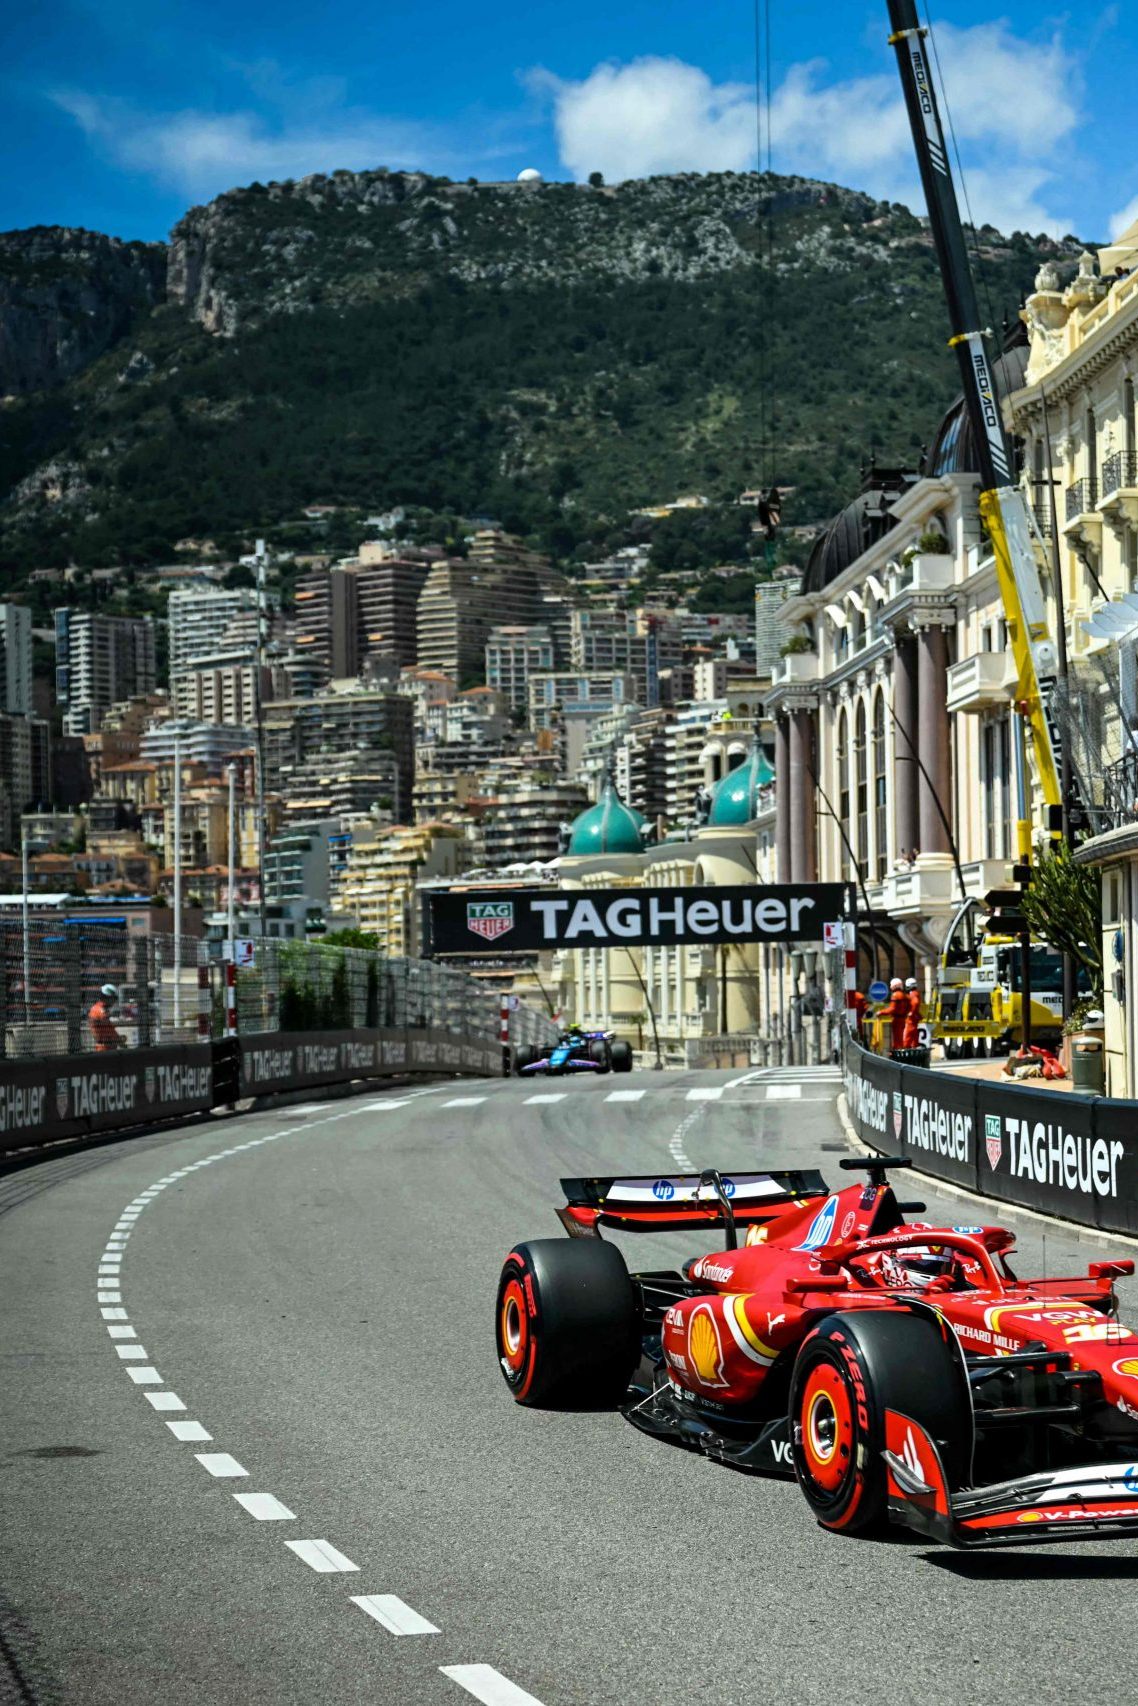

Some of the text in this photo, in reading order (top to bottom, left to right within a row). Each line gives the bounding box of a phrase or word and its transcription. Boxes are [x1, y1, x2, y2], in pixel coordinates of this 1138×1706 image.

[470, 904, 509, 918] TAG
[469, 919, 511, 938] HEUER
[653, 1180, 675, 1200] hp
[870, 1235, 913, 1246] TECHNOLOGY
[1014, 1309, 1105, 1322] VGW
[1052, 1318, 1097, 1326] PLAY
[954, 1322, 992, 1344] RICHARD
[1062, 1323, 1134, 1345] 16
[841, 1344, 869, 1431] ZERO
